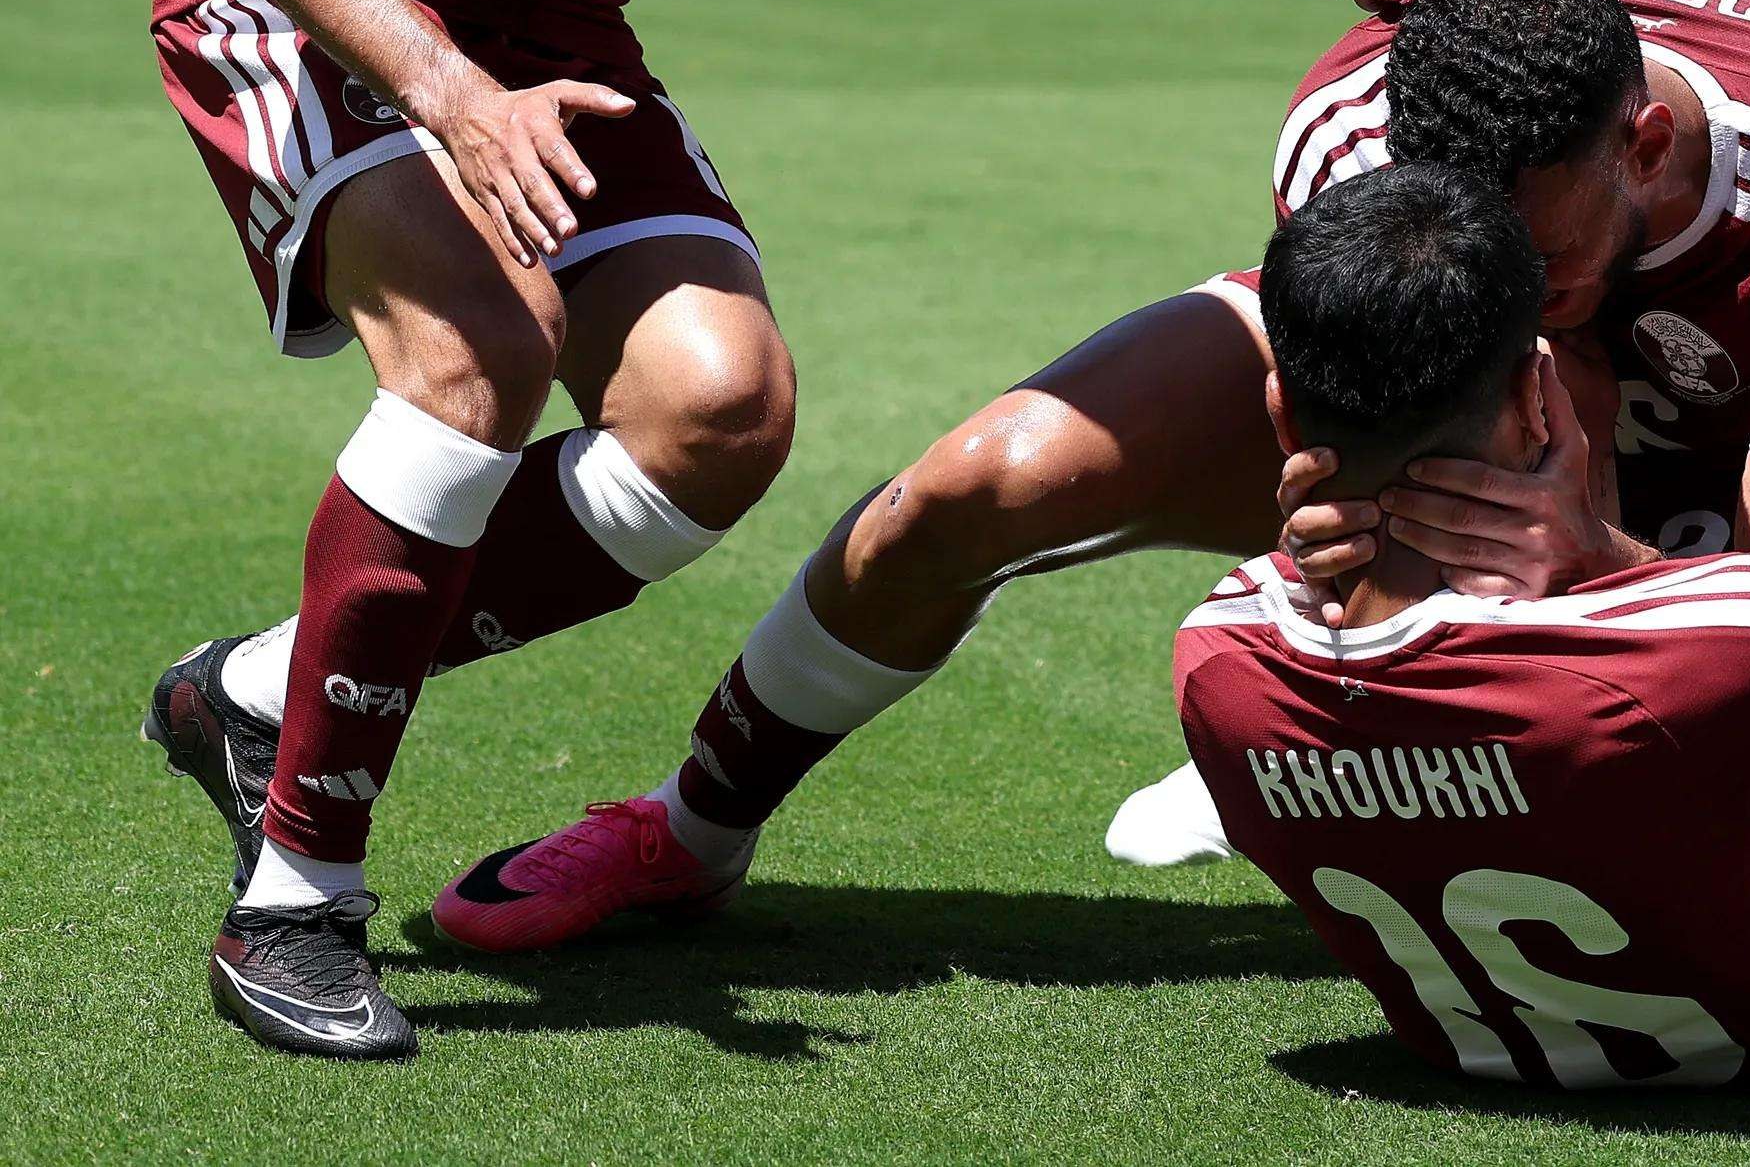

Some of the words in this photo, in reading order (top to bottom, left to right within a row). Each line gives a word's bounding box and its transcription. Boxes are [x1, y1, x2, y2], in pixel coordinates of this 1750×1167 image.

[324, 674, 407, 716] QFA
[1247, 743, 1530, 819] KHOUKHI
[1312, 867, 1746, 1091] 16
